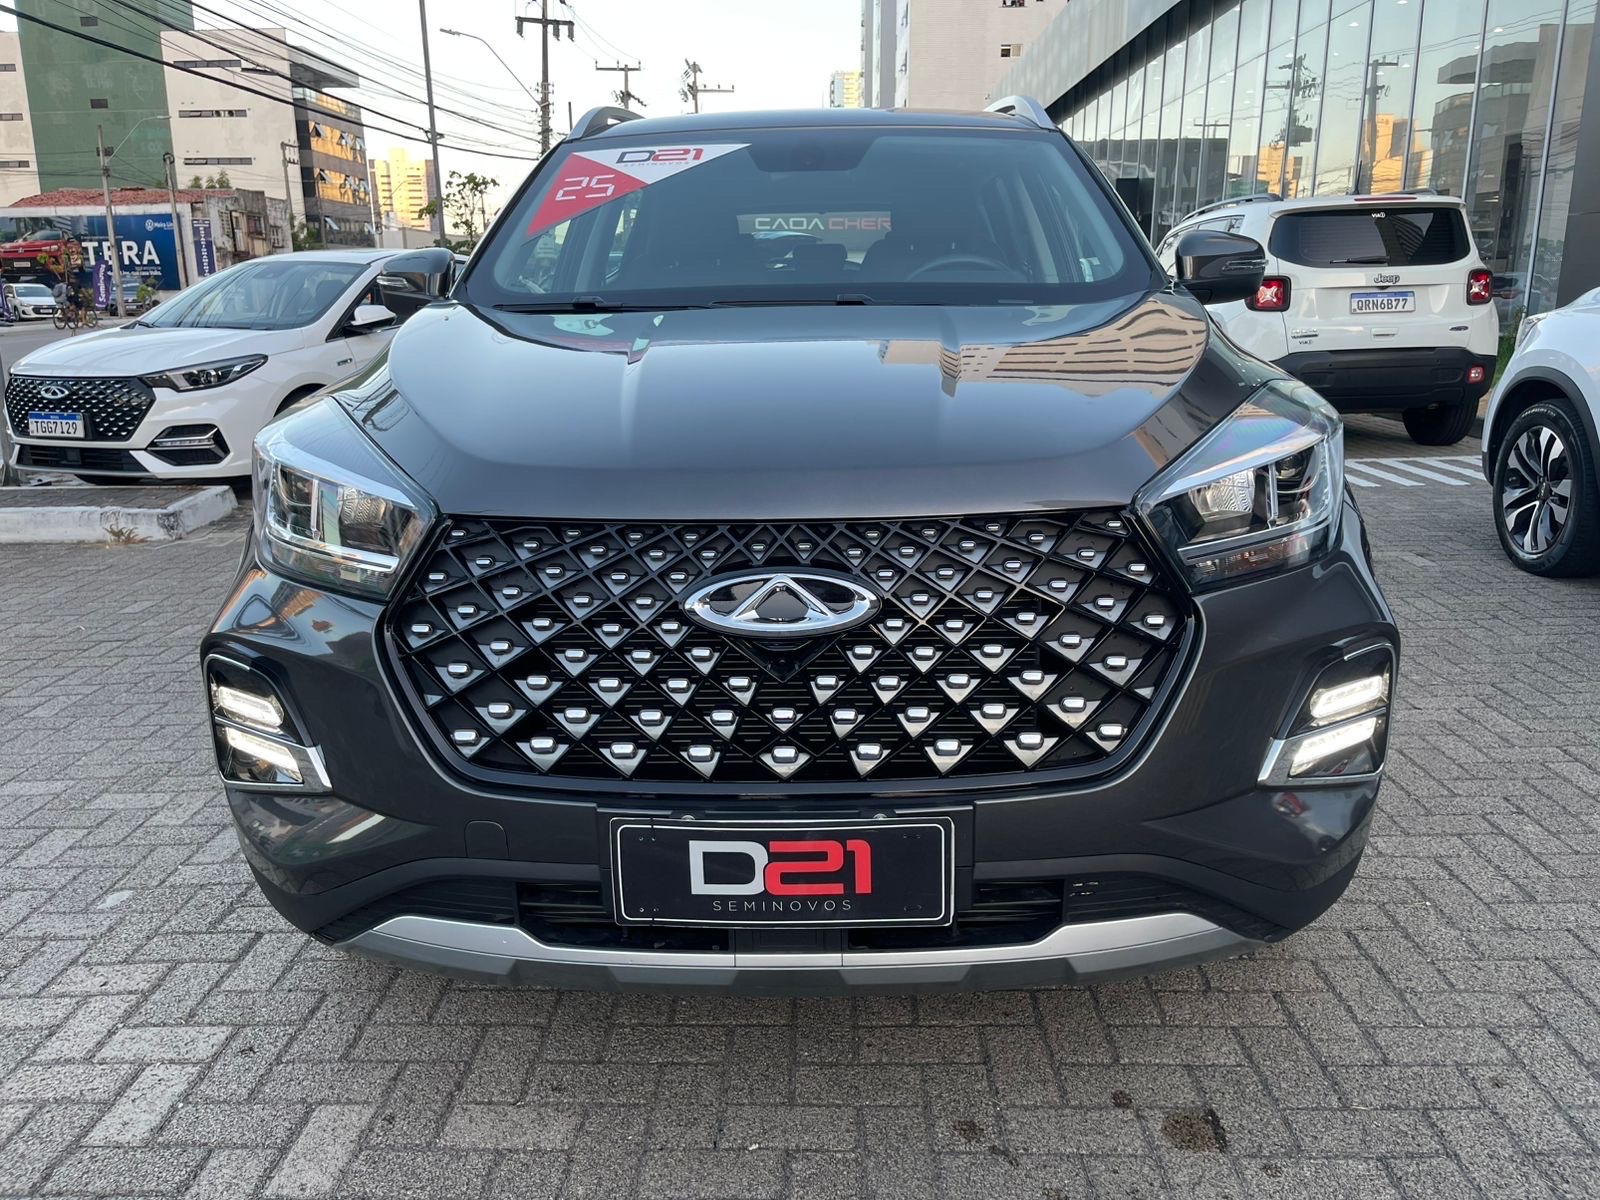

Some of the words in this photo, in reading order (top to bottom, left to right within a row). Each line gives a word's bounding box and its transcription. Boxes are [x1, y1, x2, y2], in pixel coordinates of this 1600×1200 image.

[616, 148, 704, 164] D21
[555, 174, 615, 201] 25
[755, 217, 825, 231] CAOA
[1373, 273, 1400, 285] Jeep
[1356, 298, 1408, 311] QRN6B77
[34, 420, 78, 435] TGG7129
[689, 840, 872, 895] D21
[712, 900, 852, 911] SEMINOVOS
